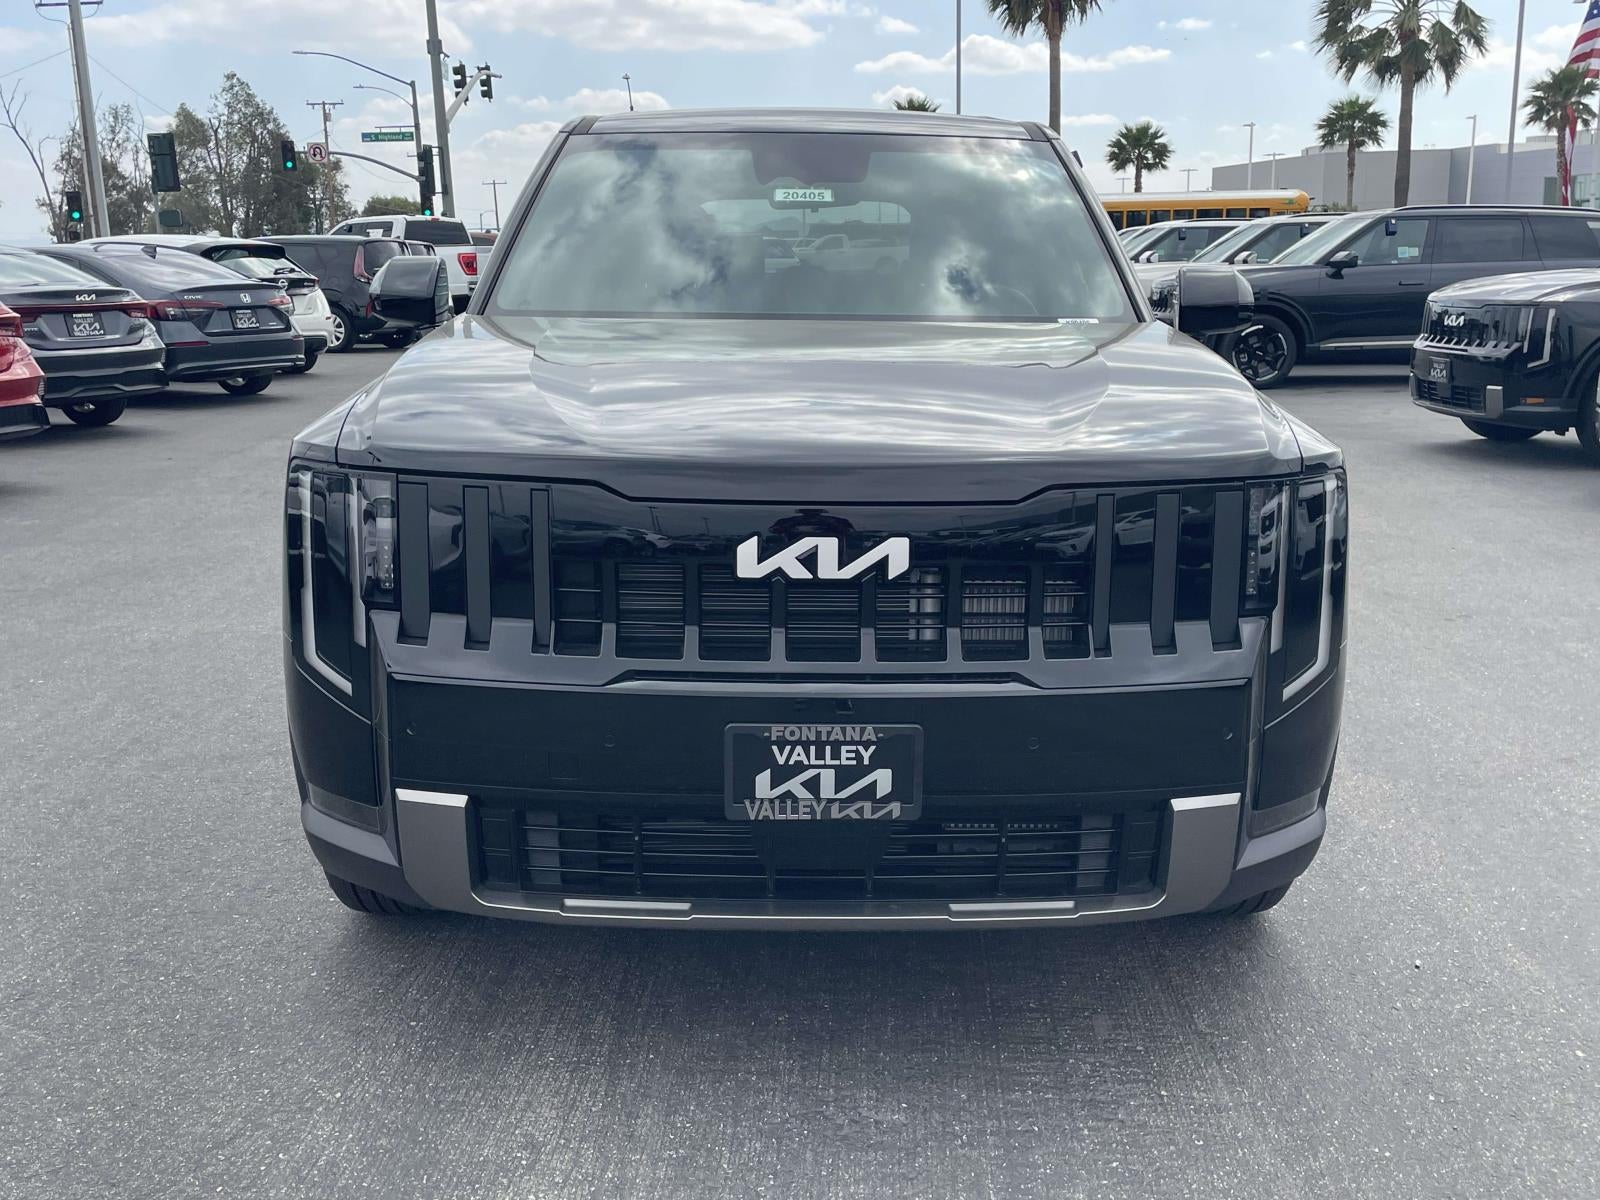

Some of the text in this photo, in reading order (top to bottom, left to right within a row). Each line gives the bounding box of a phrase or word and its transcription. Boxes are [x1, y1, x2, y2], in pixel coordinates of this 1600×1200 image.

[783, 191, 825, 200] 20405
[75, 293, 96, 301] KIA
[1444, 314, 1465, 326] KIA
[73, 322, 100, 332] KIA
[1431, 368, 1446, 378] KIA
[737, 535, 909, 580] KIA
[771, 744, 877, 766] VALLEY
[755, 768, 893, 799] KIA
[744, 799, 901, 820] VALLEY KIA
